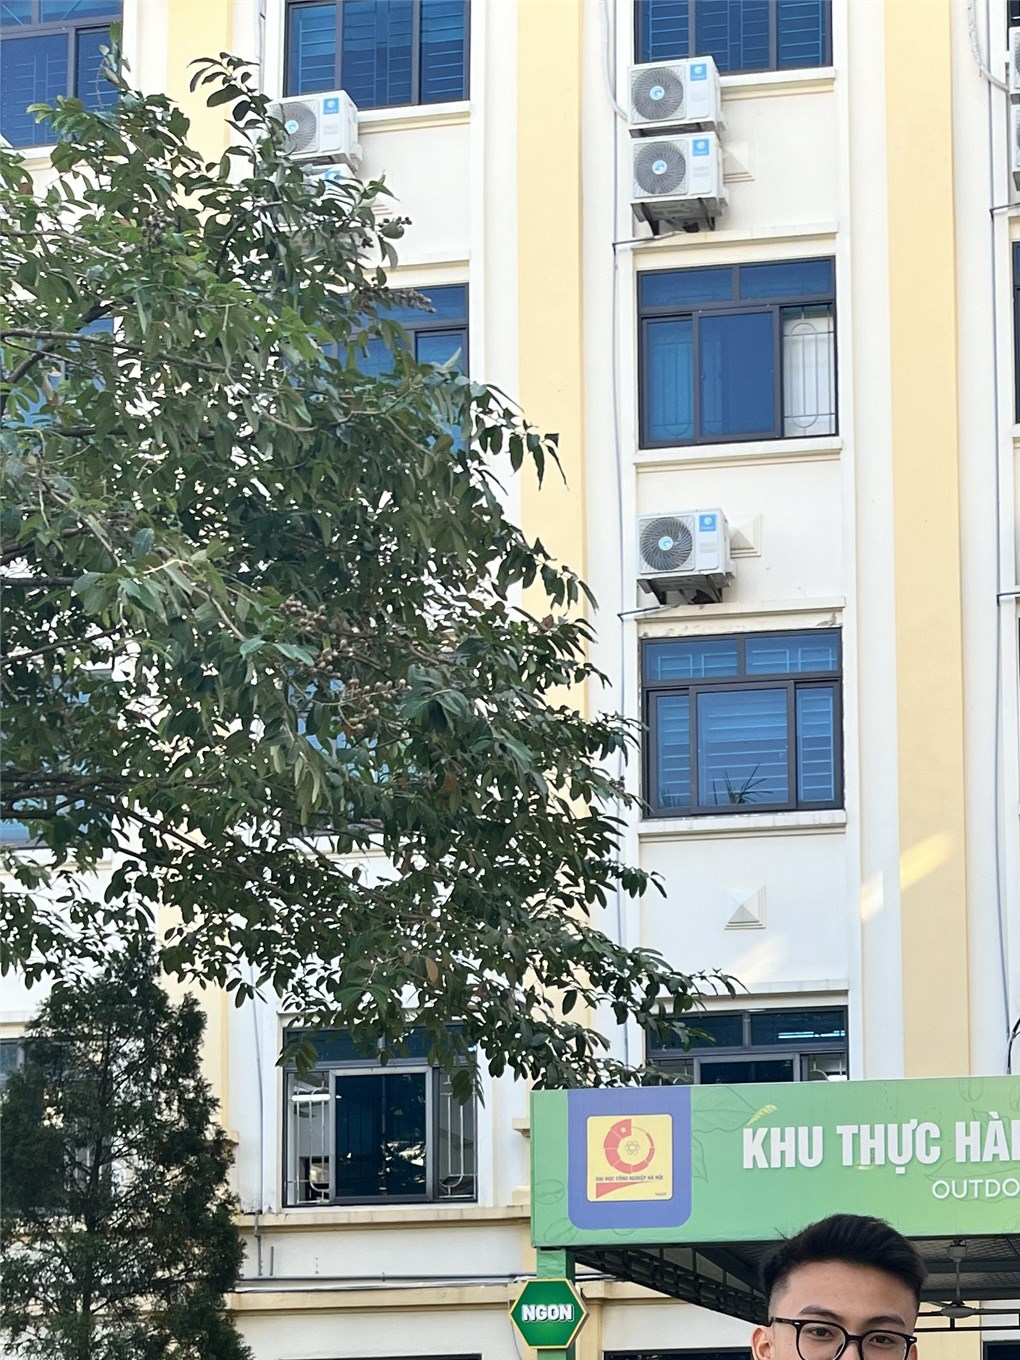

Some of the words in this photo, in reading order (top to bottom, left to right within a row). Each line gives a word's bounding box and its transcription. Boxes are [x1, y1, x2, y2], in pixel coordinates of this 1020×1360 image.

[742, 1126, 824, 1170] KHU
[836, 1117, 941, 1175] THỰC
[522, 1304, 574, 1323] NGON
